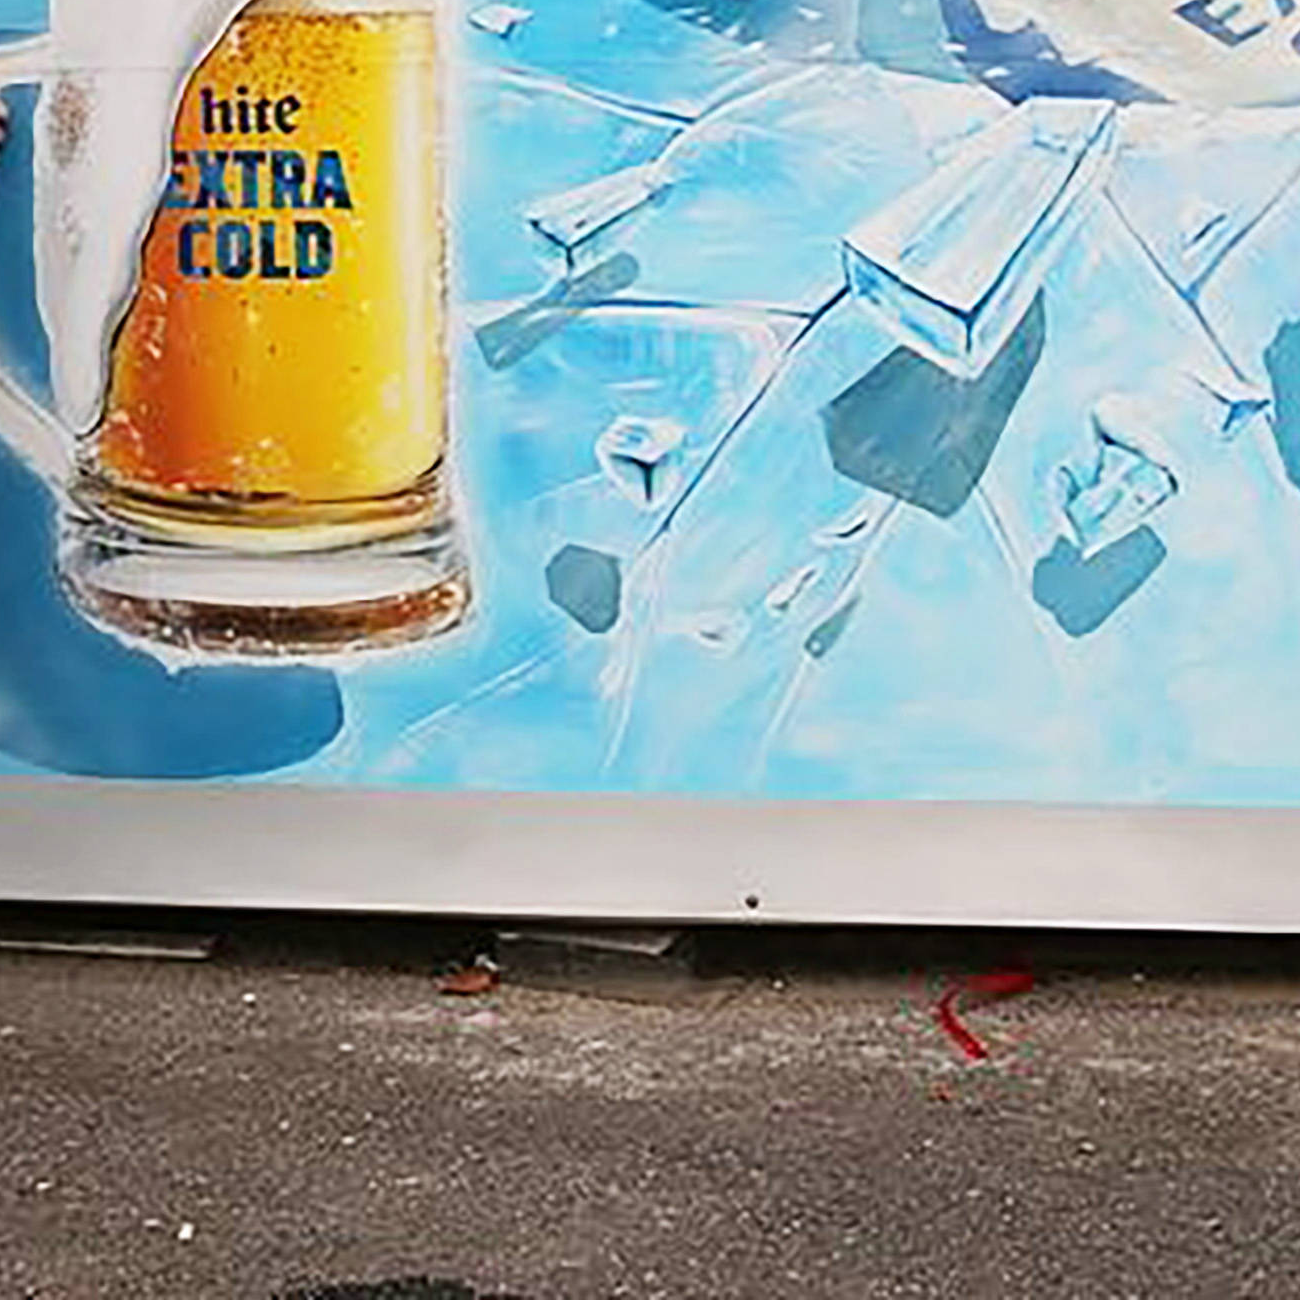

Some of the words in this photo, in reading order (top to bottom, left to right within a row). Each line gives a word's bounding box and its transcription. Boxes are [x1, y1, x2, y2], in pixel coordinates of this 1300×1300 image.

[200, 85, 300, 133] hite
[164, 150, 353, 209] EXTRA
[178, 220, 333, 279] COLD
